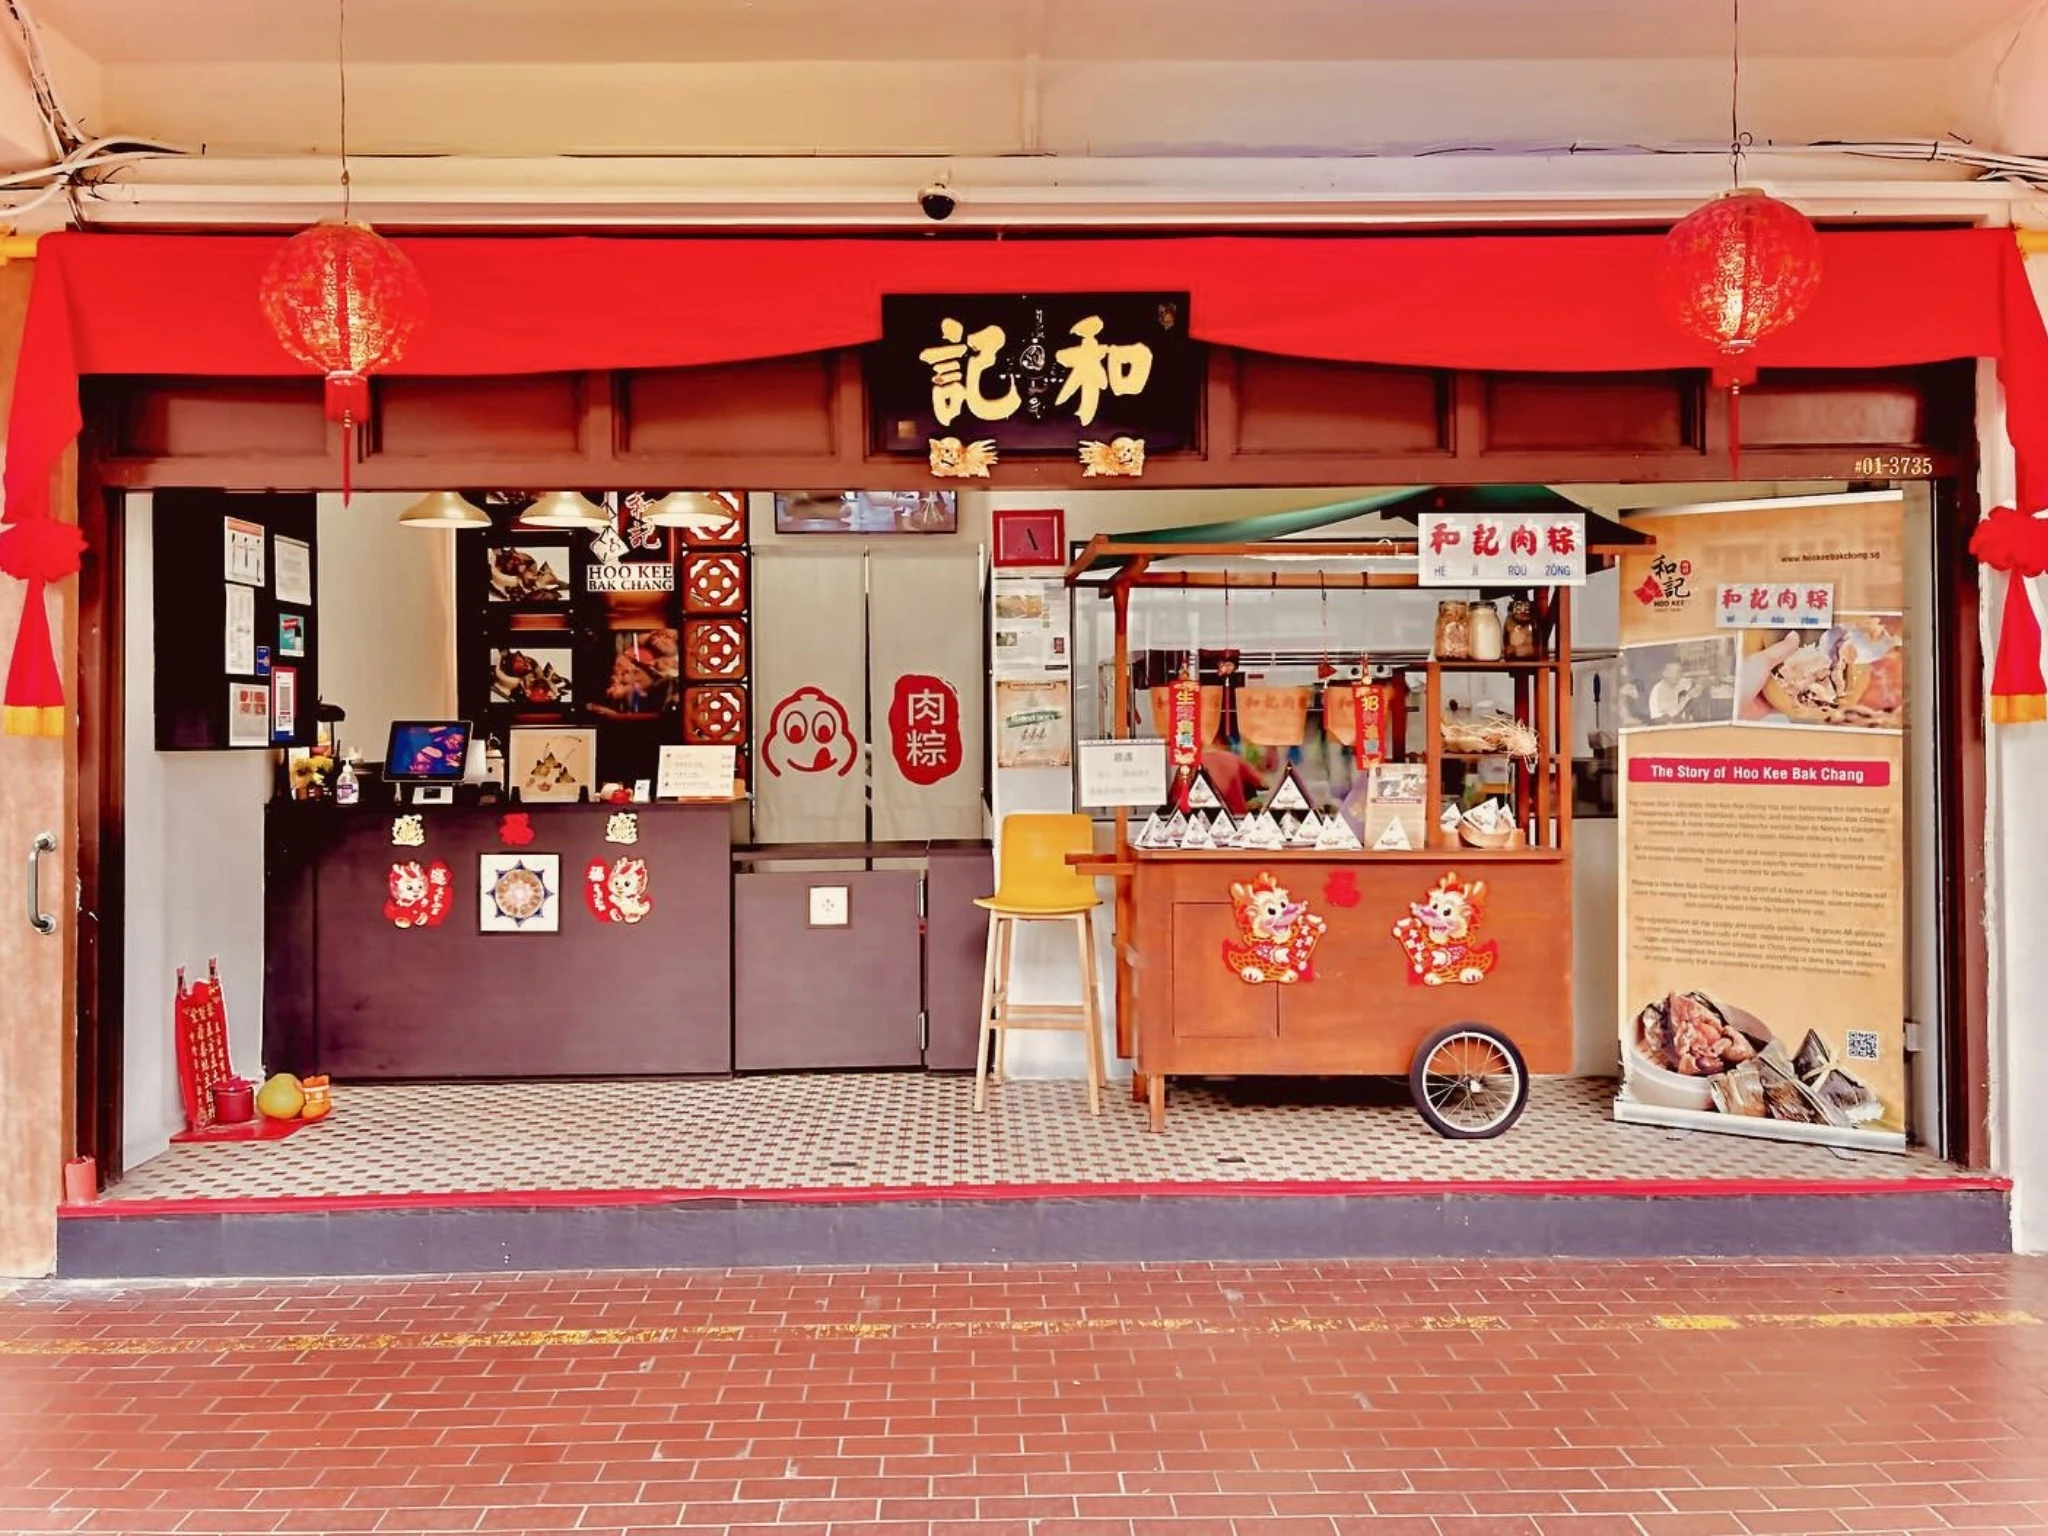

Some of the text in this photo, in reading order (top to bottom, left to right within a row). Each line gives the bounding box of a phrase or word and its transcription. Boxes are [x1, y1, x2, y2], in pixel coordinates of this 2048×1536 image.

[1855, 456, 1933, 475] #01-3735
[1430, 523, 1575, 557] 和記肉粽
[588, 565, 673, 579] HOO KEE
[588, 580, 673, 590] BAK CHANG
[906, 688, 947, 767] 肉粽
[1651, 764, 1864, 784] The Story of Hoo Kee Bak Chang
